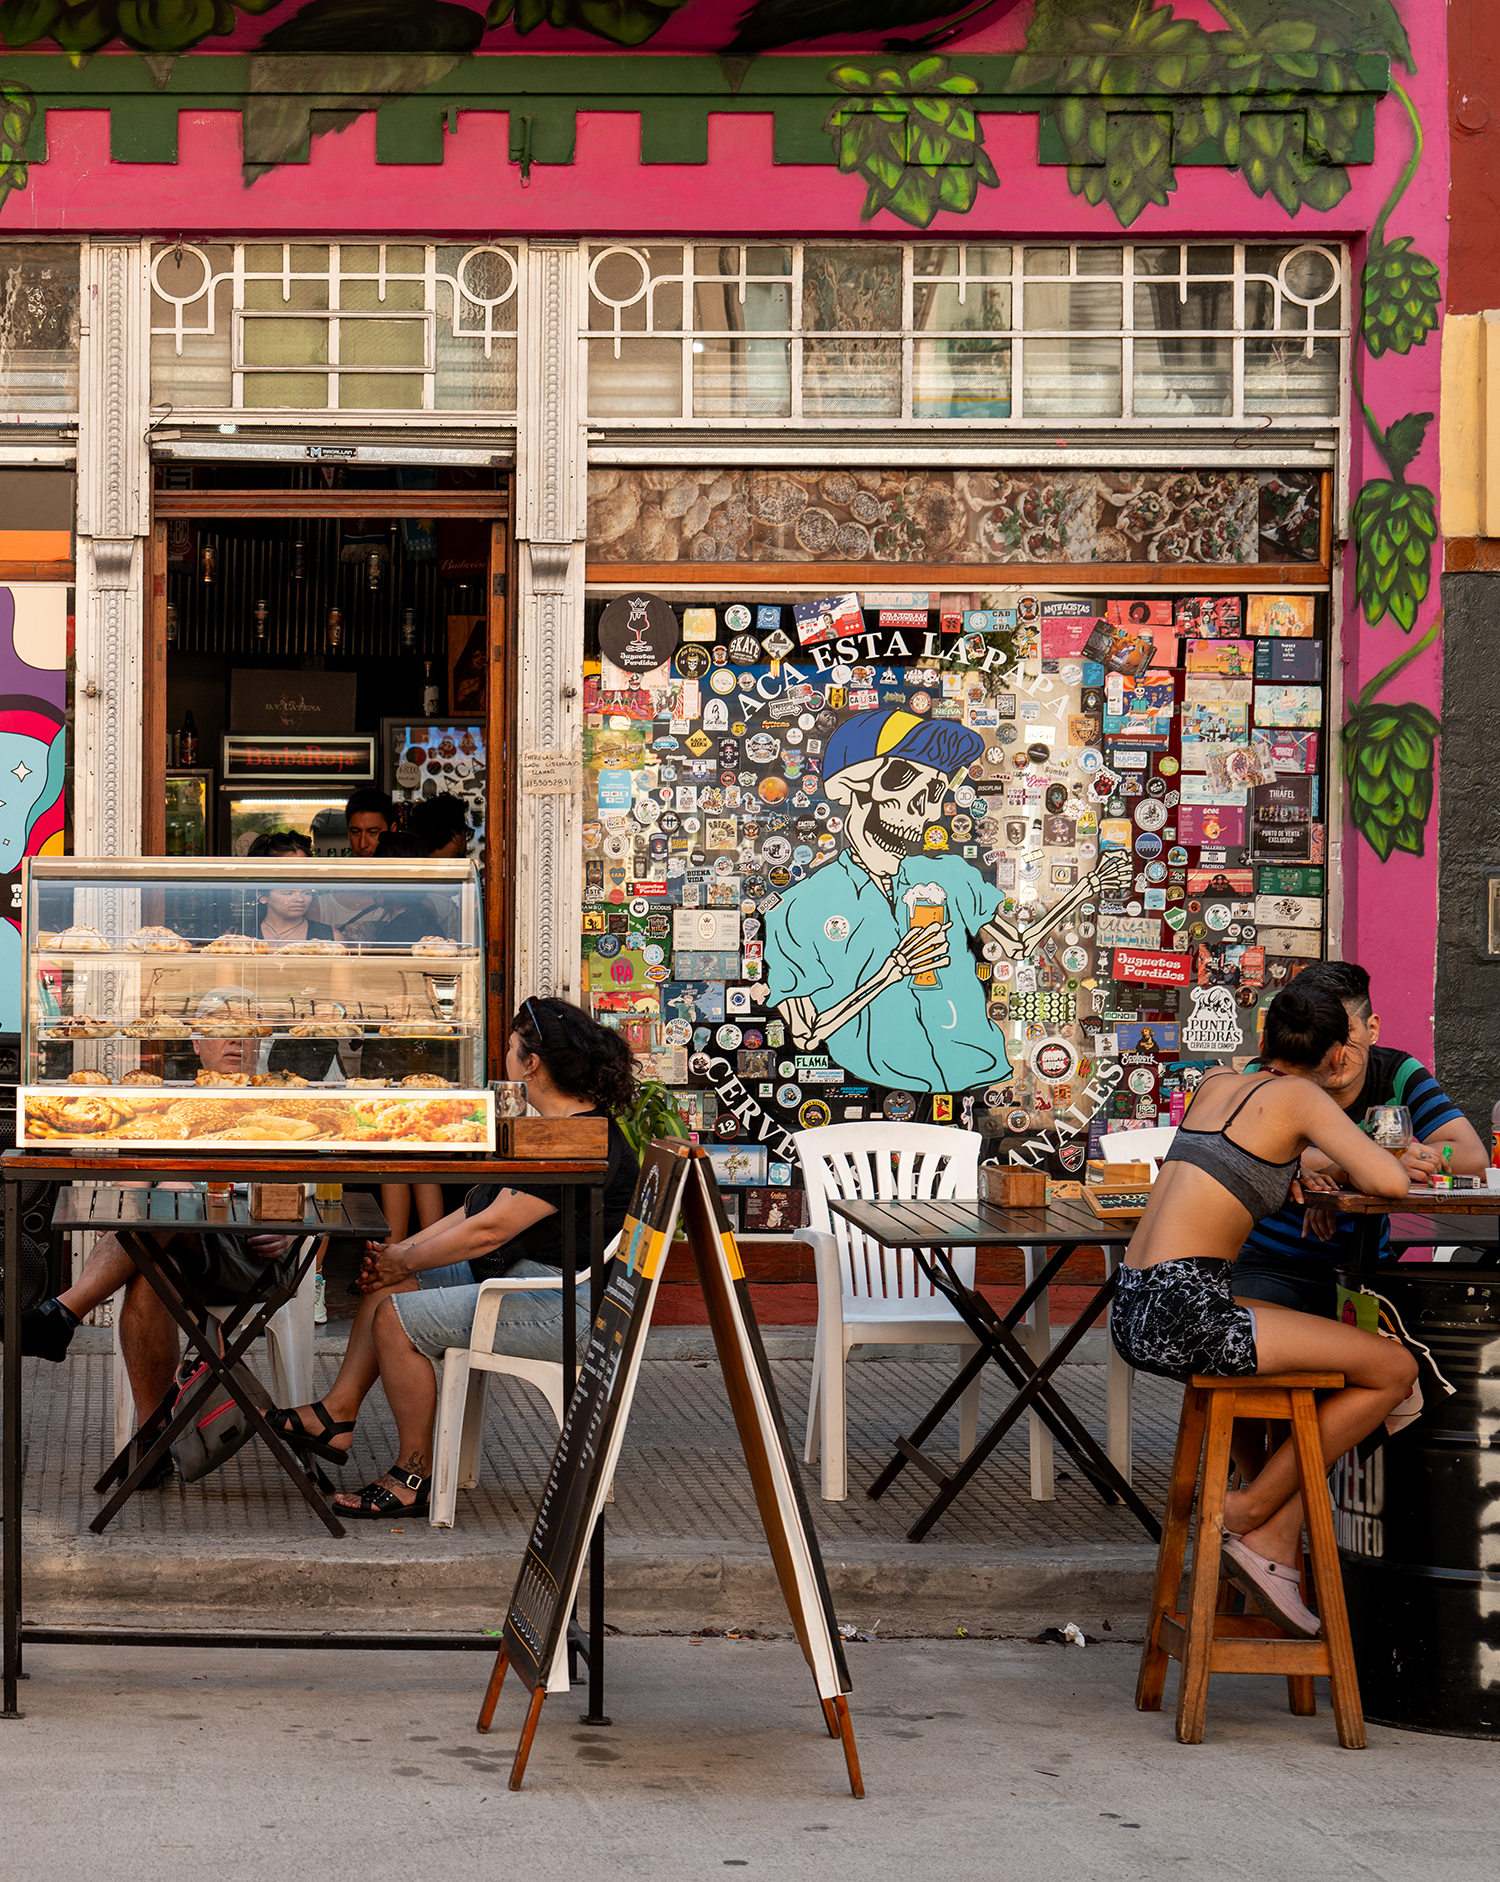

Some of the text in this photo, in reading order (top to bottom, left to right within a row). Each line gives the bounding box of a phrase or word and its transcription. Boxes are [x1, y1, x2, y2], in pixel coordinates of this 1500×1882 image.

[441, 558, 487, 571] Budweise
[729, 636, 760, 657] SKATE
[624, 659, 658, 667] Perdidos
[737, 630, 1070, 723] ACA ESTA LA PAPA
[245, 744, 355, 773] BarbaRoja
[977, 784, 1002, 792] DISCIPLINA
[959, 791, 972, 800] JD
[687, 869, 711, 877] BUENA
[759, 895, 777, 912] BORO
[1083, 925, 1091, 934] W
[1117, 952, 1182, 971] Juguetes
[610, 965, 634, 986] IPA
[1123, 964, 1186, 982] Perdidos
[1190, 1020, 1235, 1031] PUNTA
[1185, 1031, 1242, 1042] PIEDRAS
[717, 1120, 737, 1135] 12
